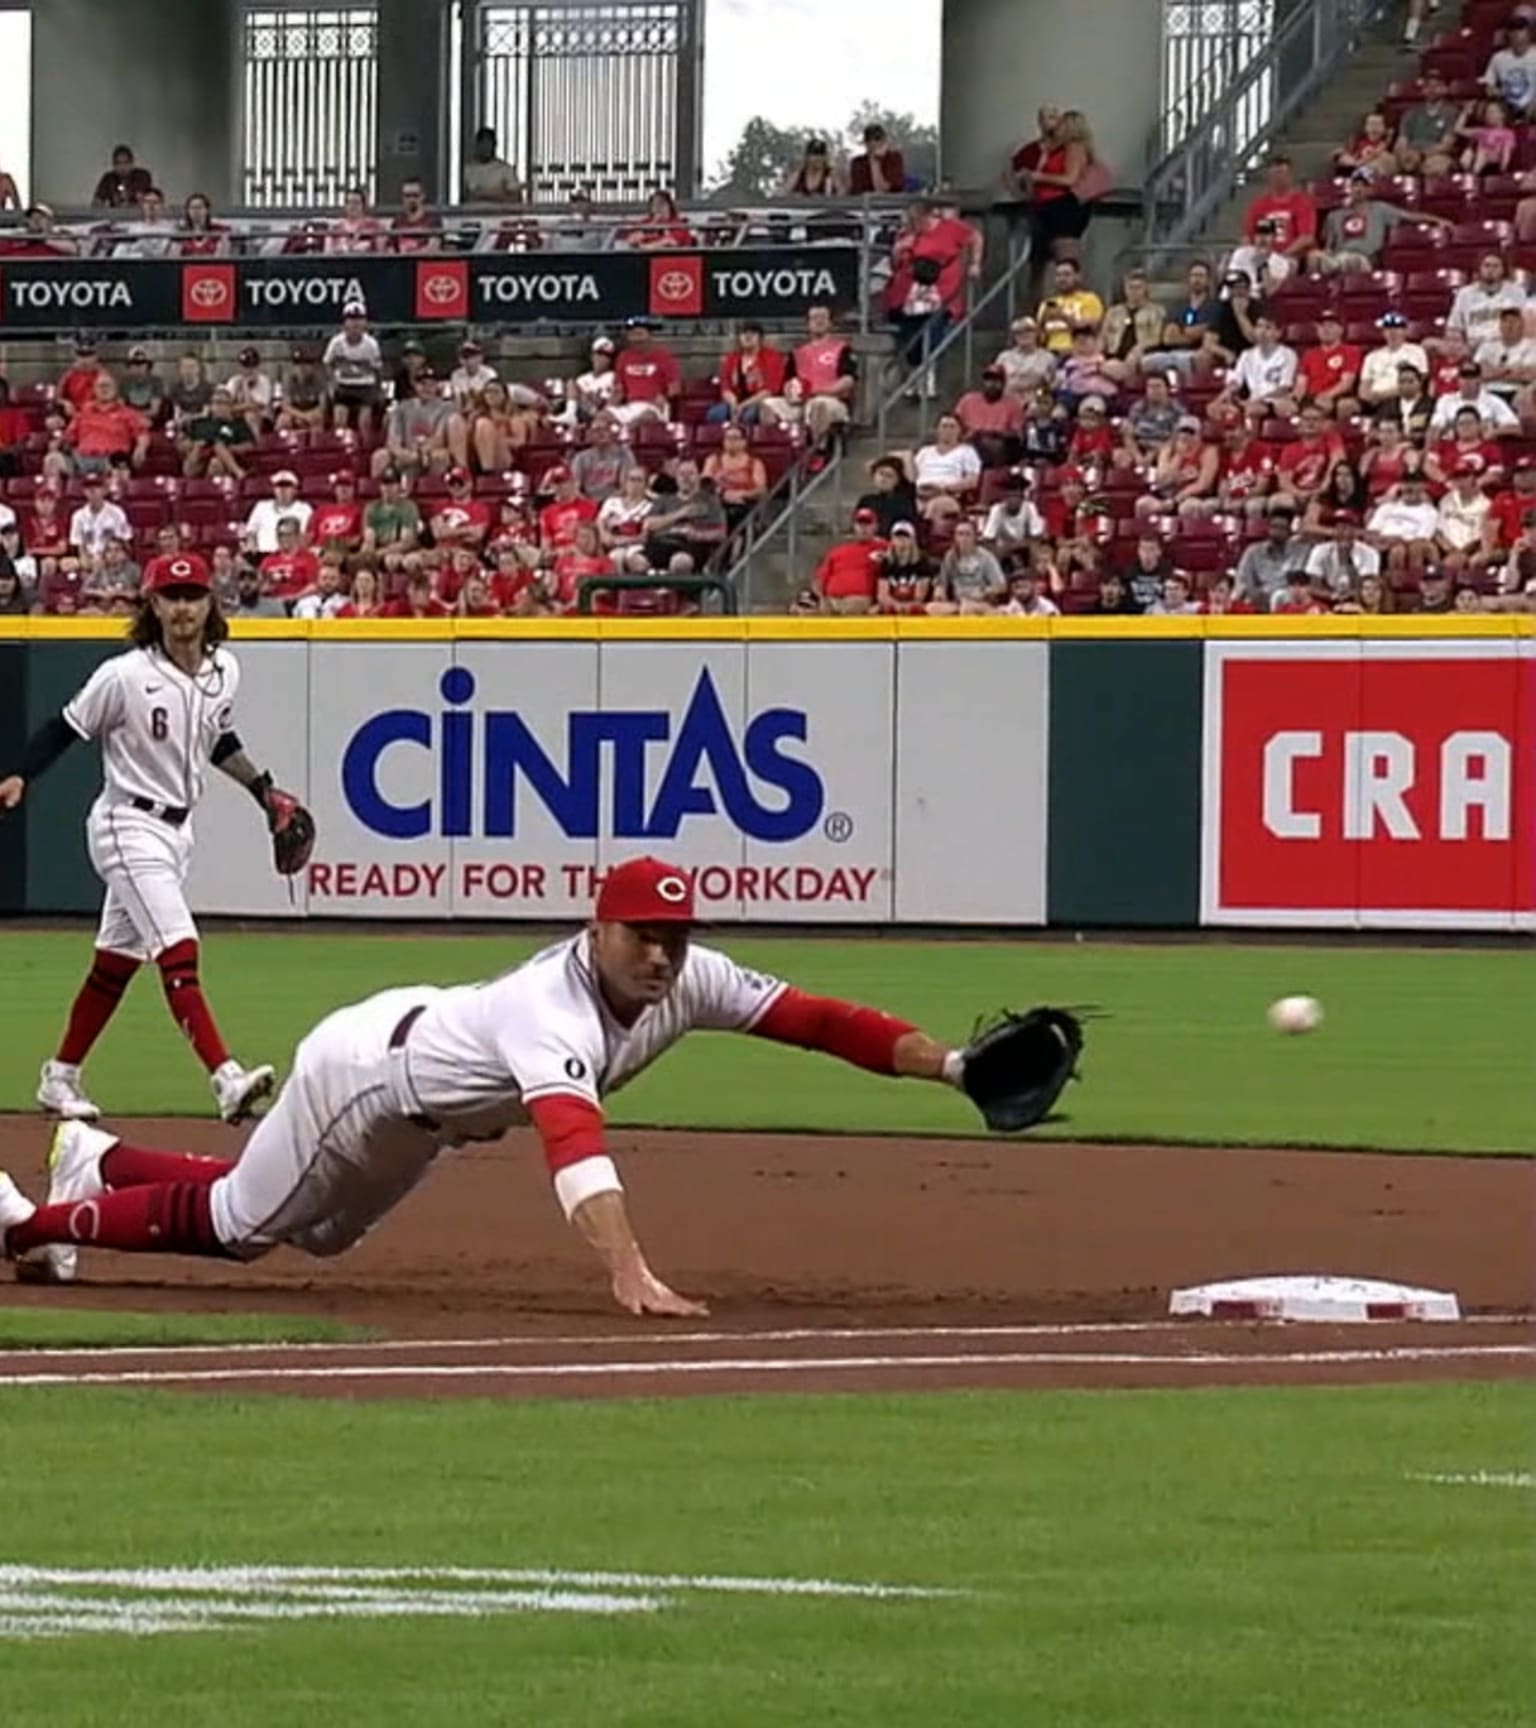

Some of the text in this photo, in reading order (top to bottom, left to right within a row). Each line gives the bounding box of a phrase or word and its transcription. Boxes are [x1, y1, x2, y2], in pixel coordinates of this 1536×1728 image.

[10, 281, 132, 307] TOYOTA
[245, 278, 365, 303] TOYOTA
[478, 274, 600, 302] TOYOTA
[712, 269, 837, 297] TOYOTA
[151, 707, 168, 741] 6
[1263, 731, 1511, 840] CRA
[309, 863, 876, 901] READY FOR TH ORKDAY
